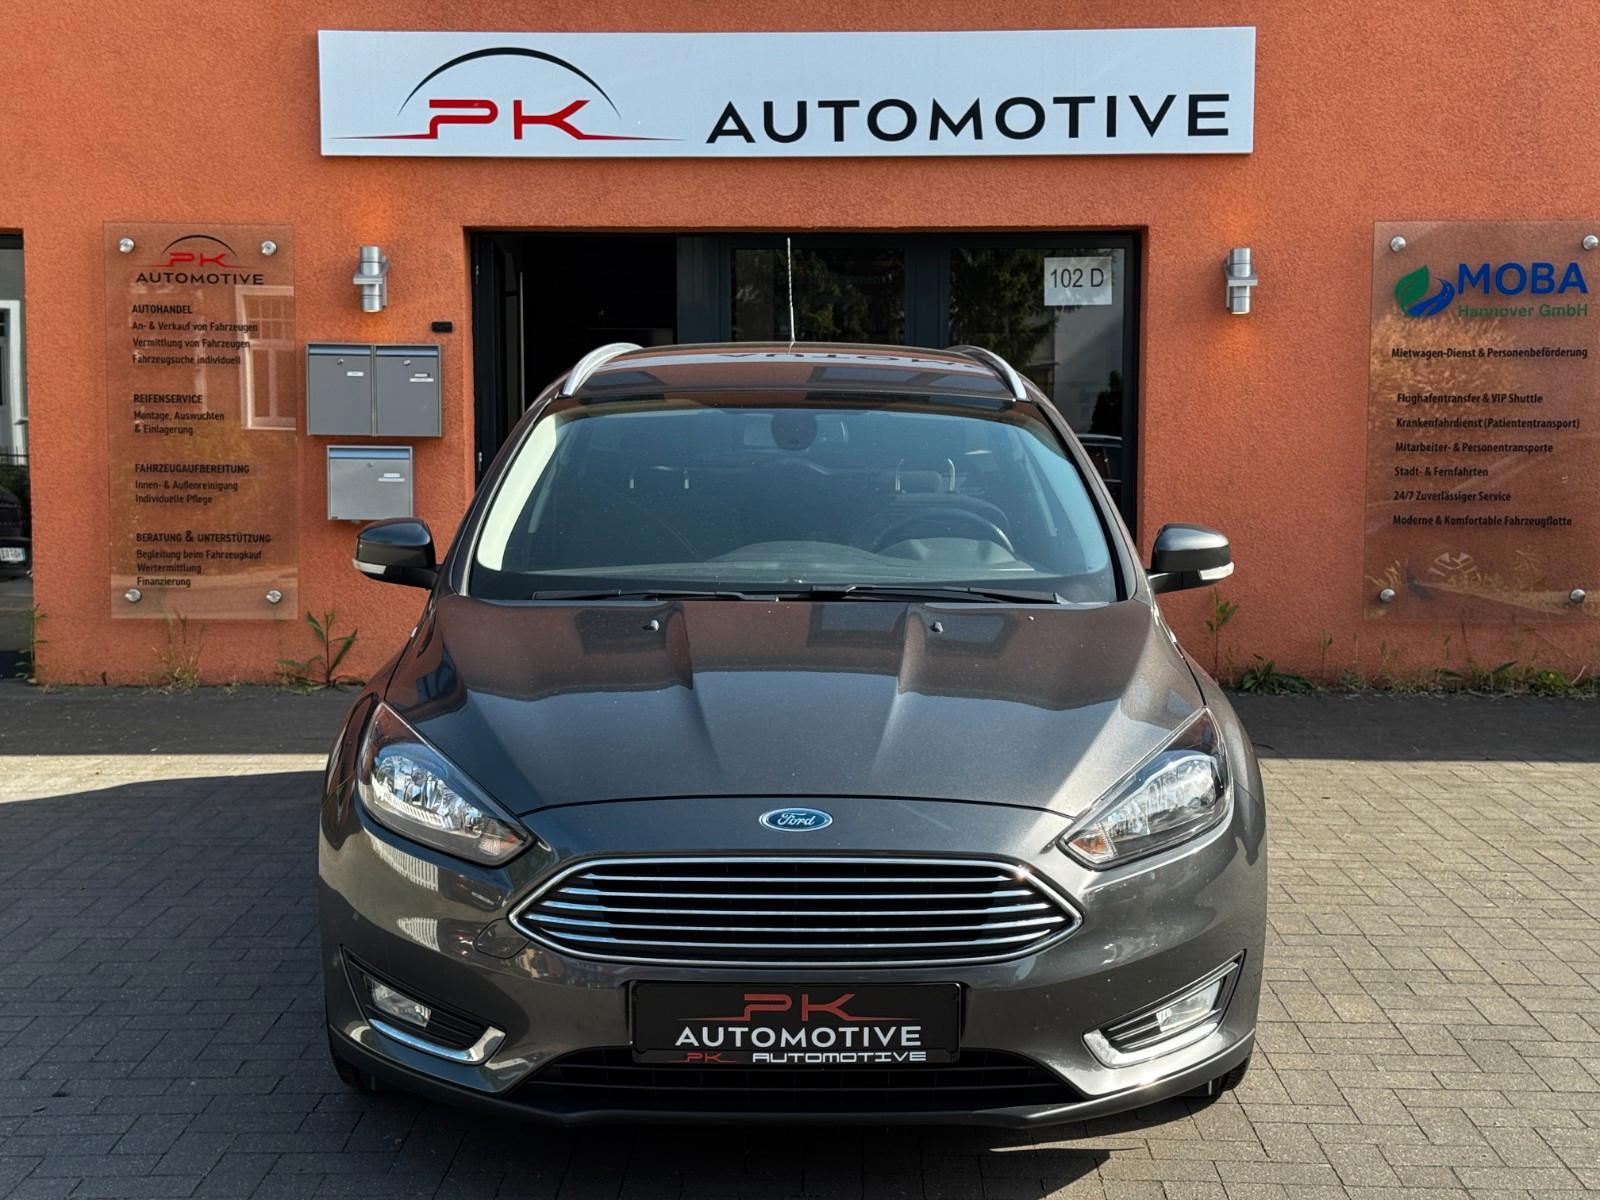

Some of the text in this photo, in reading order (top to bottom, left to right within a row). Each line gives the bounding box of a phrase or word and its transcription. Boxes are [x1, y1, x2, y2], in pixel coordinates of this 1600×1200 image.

[429, 93, 1230, 144] PK AUTOMOTIVE
[169, 253, 227, 267] PK
[136, 273, 264, 284] AUTOMOTIVE
[1051, 268, 1104, 288] 102 D
[1458, 262, 1588, 295] MOBA
[132, 305, 192, 314] AUTOHANDEL
[1458, 304, 1588, 317] Hannover GmbH
[132, 322, 146, 330] An-
[149, 322, 155, 330] &
[159, 322, 190, 331] Verkauf
[210, 322, 258, 333] Fahrzeugen
[133, 338, 182, 349] Vermittlung
[202, 339, 250, 349] Fahrzeugen
[1392, 347, 1588, 360] Mietwagen-Dienst & Personenbeförderung
[133, 356, 240, 365] Fahrzeugsuche individuell
[134, 394, 203, 403] REIFENSERVICE
[1397, 393, 1480, 405] Flughafentransfer
[1482, 394, 1489, 403] &
[1509, 393, 1543, 403] Shuttle
[134, 411, 224, 421] Montage, Auswuchten
[134, 424, 193, 435] & Einlagerung
[1396, 418, 1580, 430] Krankenfahrdienst (Patiententransport)
[1396, 442, 1553, 454] Mitarbeiter- & Personentransporte
[135, 464, 250, 474] FAHRZEUGAUFBEREITUNG
[1394, 467, 1488, 476] Stadt- & Fernfahrten
[135, 481, 238, 492] Innen- & Außenreinigung
[136, 494, 212, 505] Individuelle Pflege
[1393, 491, 1511, 503] 24/7 Zuverlässiger Service
[1393, 515, 1572, 528] Moderne & Komfortable Fahrzeugflotte
[136, 531, 271, 543] BERATUNG & UNTERSTÜTZUNG
[136, 550, 262, 560] Begleitung beim Fahrzeugkauf
[137, 563, 201, 574] Wertermittlung
[137, 577, 191, 587] Finanzierung
[777, 813, 816, 825] Ford
[744, 993, 856, 1022] PK
[675, 1026, 921, 1048] AUTOMOTIVE
[686, 1052, 927, 1063] PK AUTOMOTIVE
